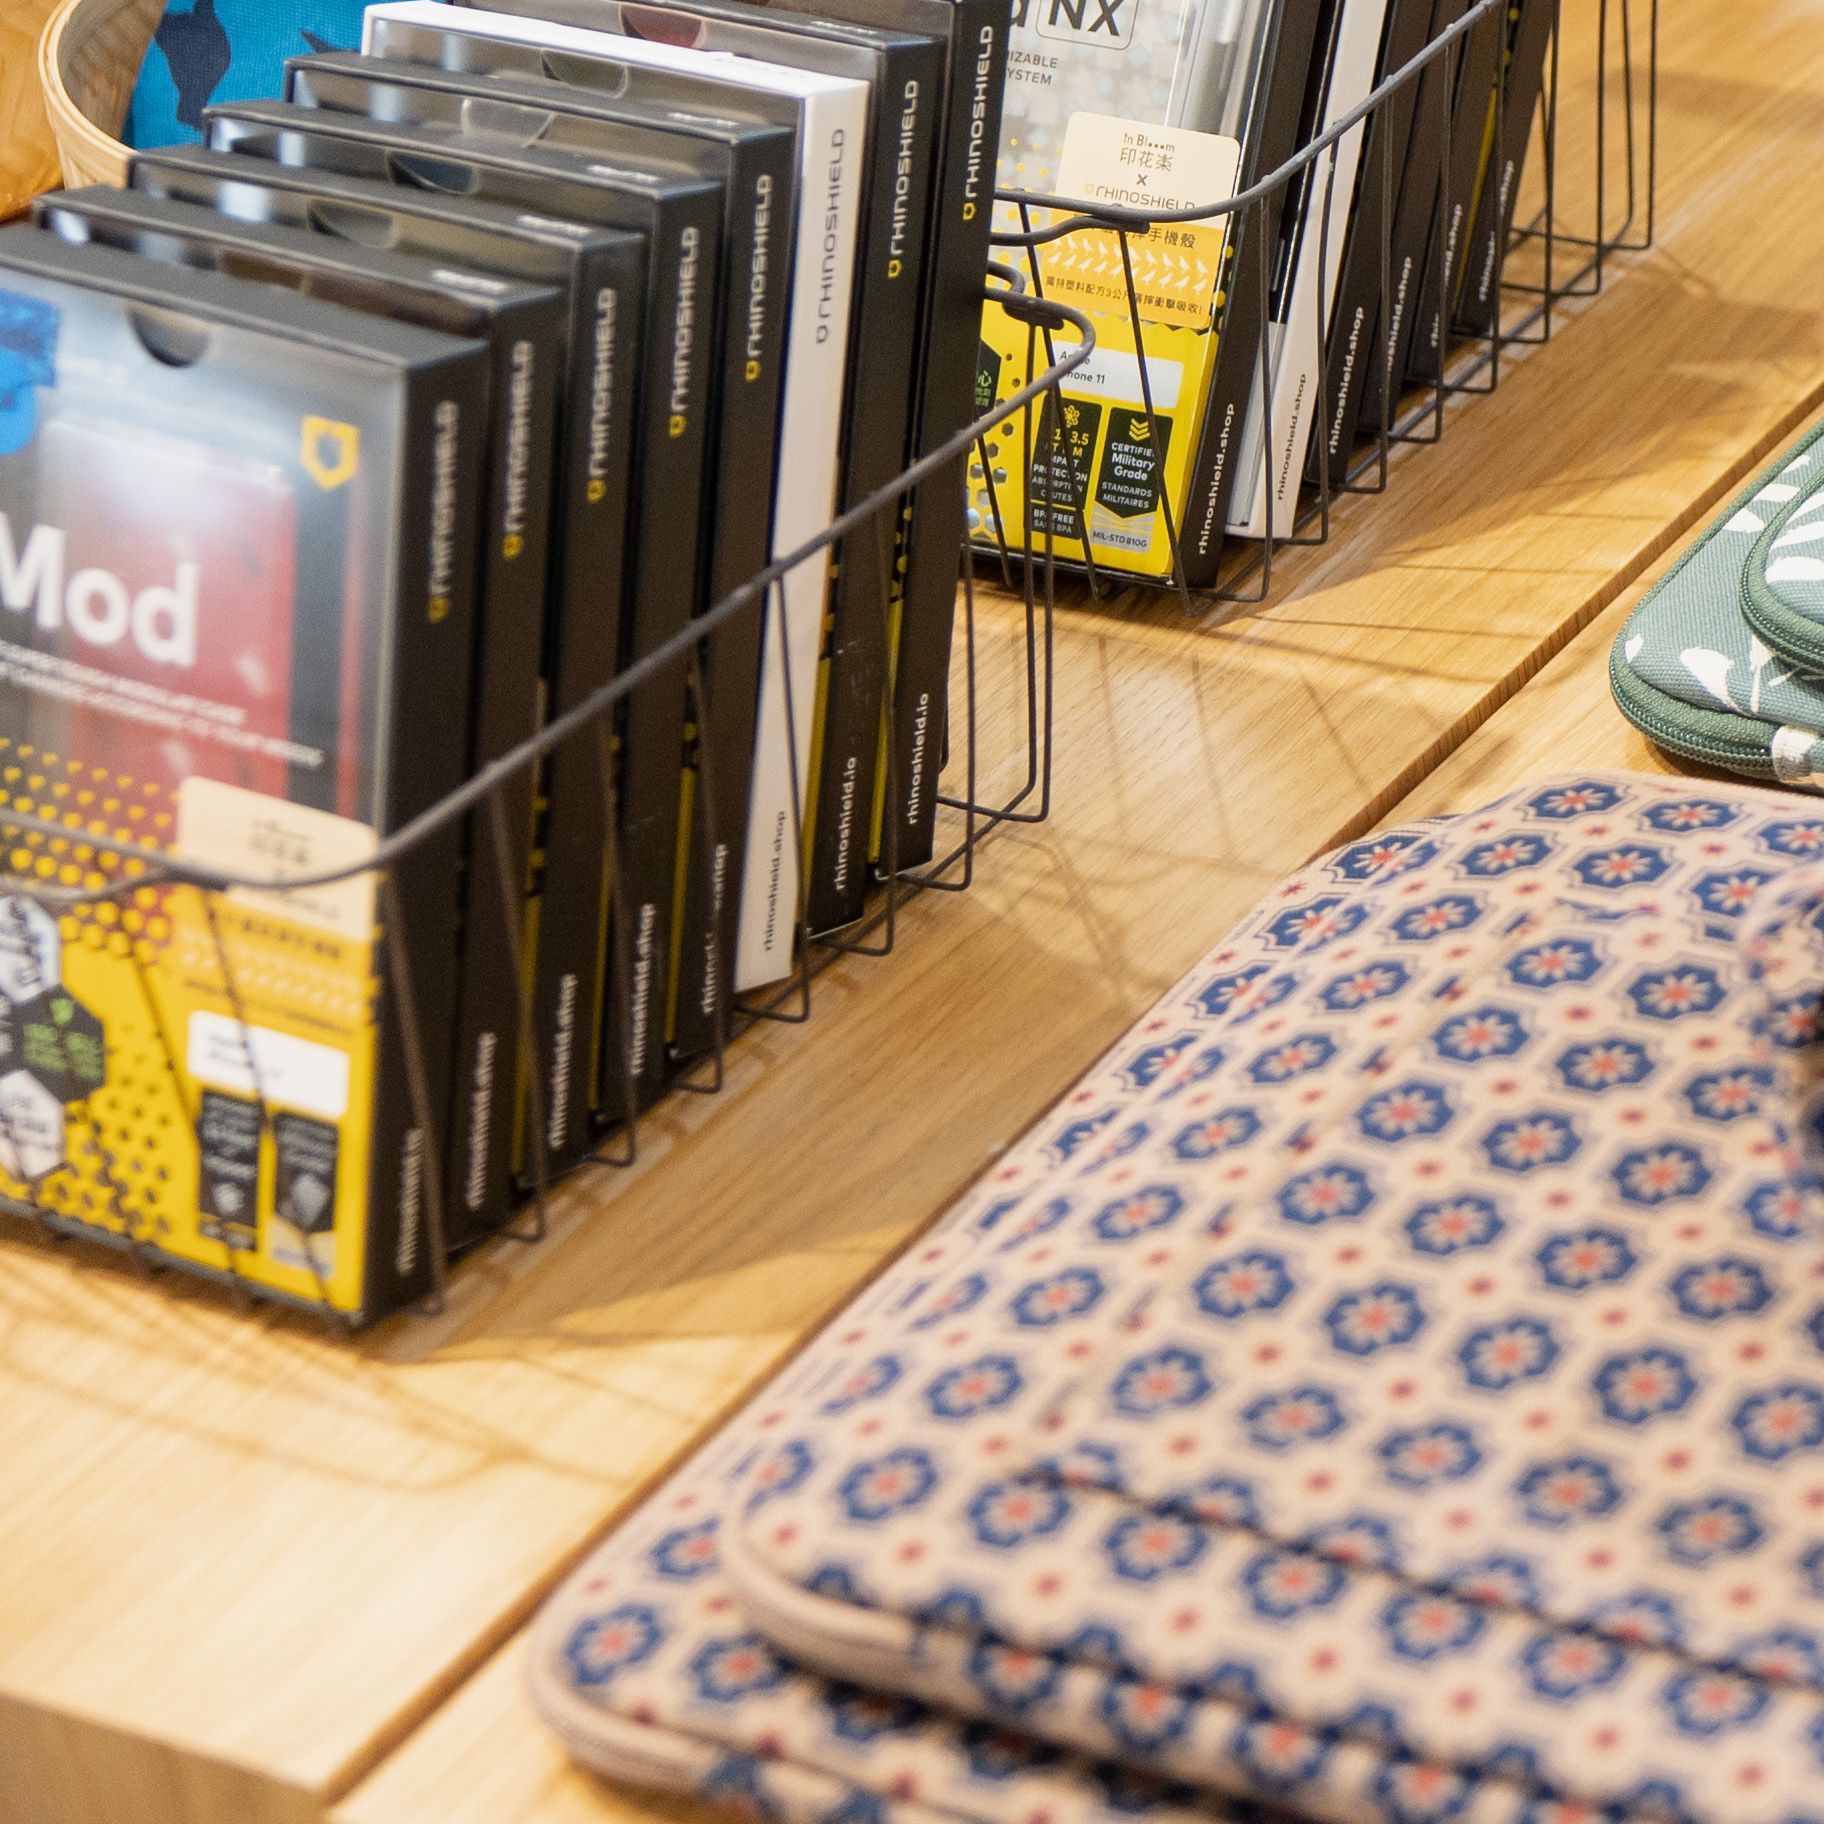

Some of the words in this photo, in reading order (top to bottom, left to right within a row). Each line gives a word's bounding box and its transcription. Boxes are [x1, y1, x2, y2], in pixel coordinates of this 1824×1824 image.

[891, 80, 919, 255] RHINOSHIELD
[966, 25, 993, 198] RHINOSHIELD
[747, 174, 772, 357] RHINOSHIELD
[819, 128, 844, 321] RHINOSHIELD
[671, 226, 699, 413] RHINOSHIELD
[1096, 374, 1105, 384] 11
[1329, 307, 1364, 455] rhinoshield.shop
[1102, 481, 1153, 498] STANDARDS
[1102, 493, 1150, 509] MILITAIRES
[1111, 441, 1155, 457] CERTIFIE
[1111, 453, 1156, 471] Military
[1114, 465, 1148, 481] Grade
[1199, 404, 1235, 555] rhinoshield.shop
[1277, 373, 1306, 501] rhinoshield.shop
[1052, 513, 1074, 525] FREE
[0, 512, 198, 669] Mod
[835, 757, 857, 891] rhinoshield.io
[909, 692, 929, 825] rhinoshield.io
[764, 810, 786, 952] rhinoshield.shop
